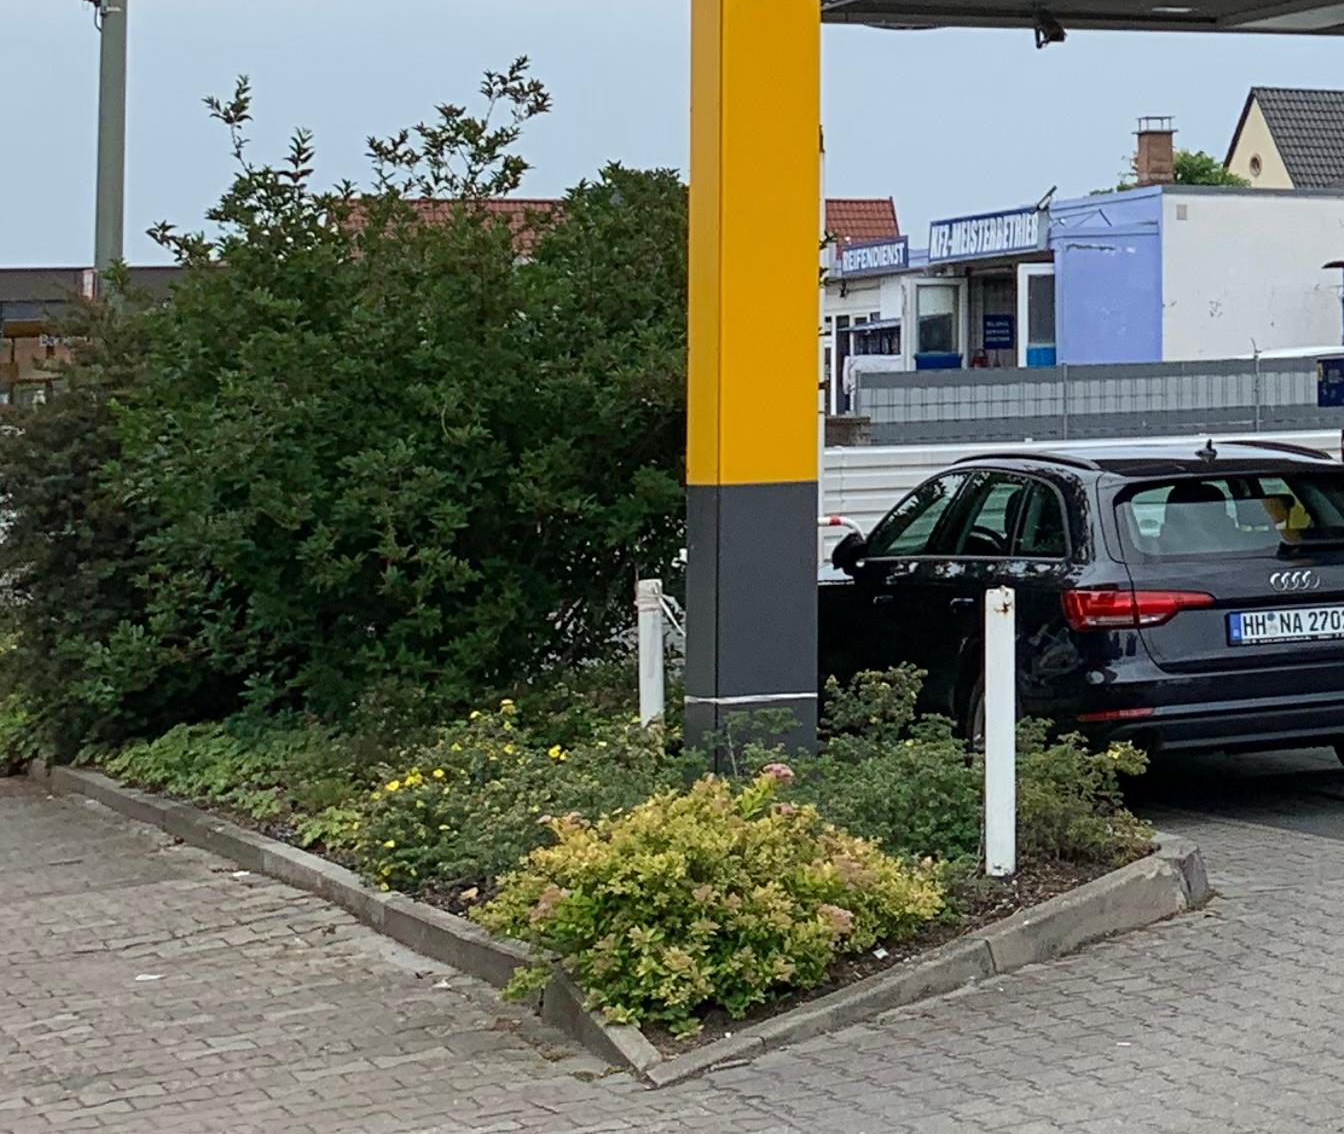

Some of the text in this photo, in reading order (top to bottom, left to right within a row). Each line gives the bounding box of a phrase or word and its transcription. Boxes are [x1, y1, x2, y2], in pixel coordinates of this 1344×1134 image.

[842, 242, 905, 269] REIFENDIENST
[1244, 616, 1265, 636] HH
[1280, 613, 1302, 633] NA
